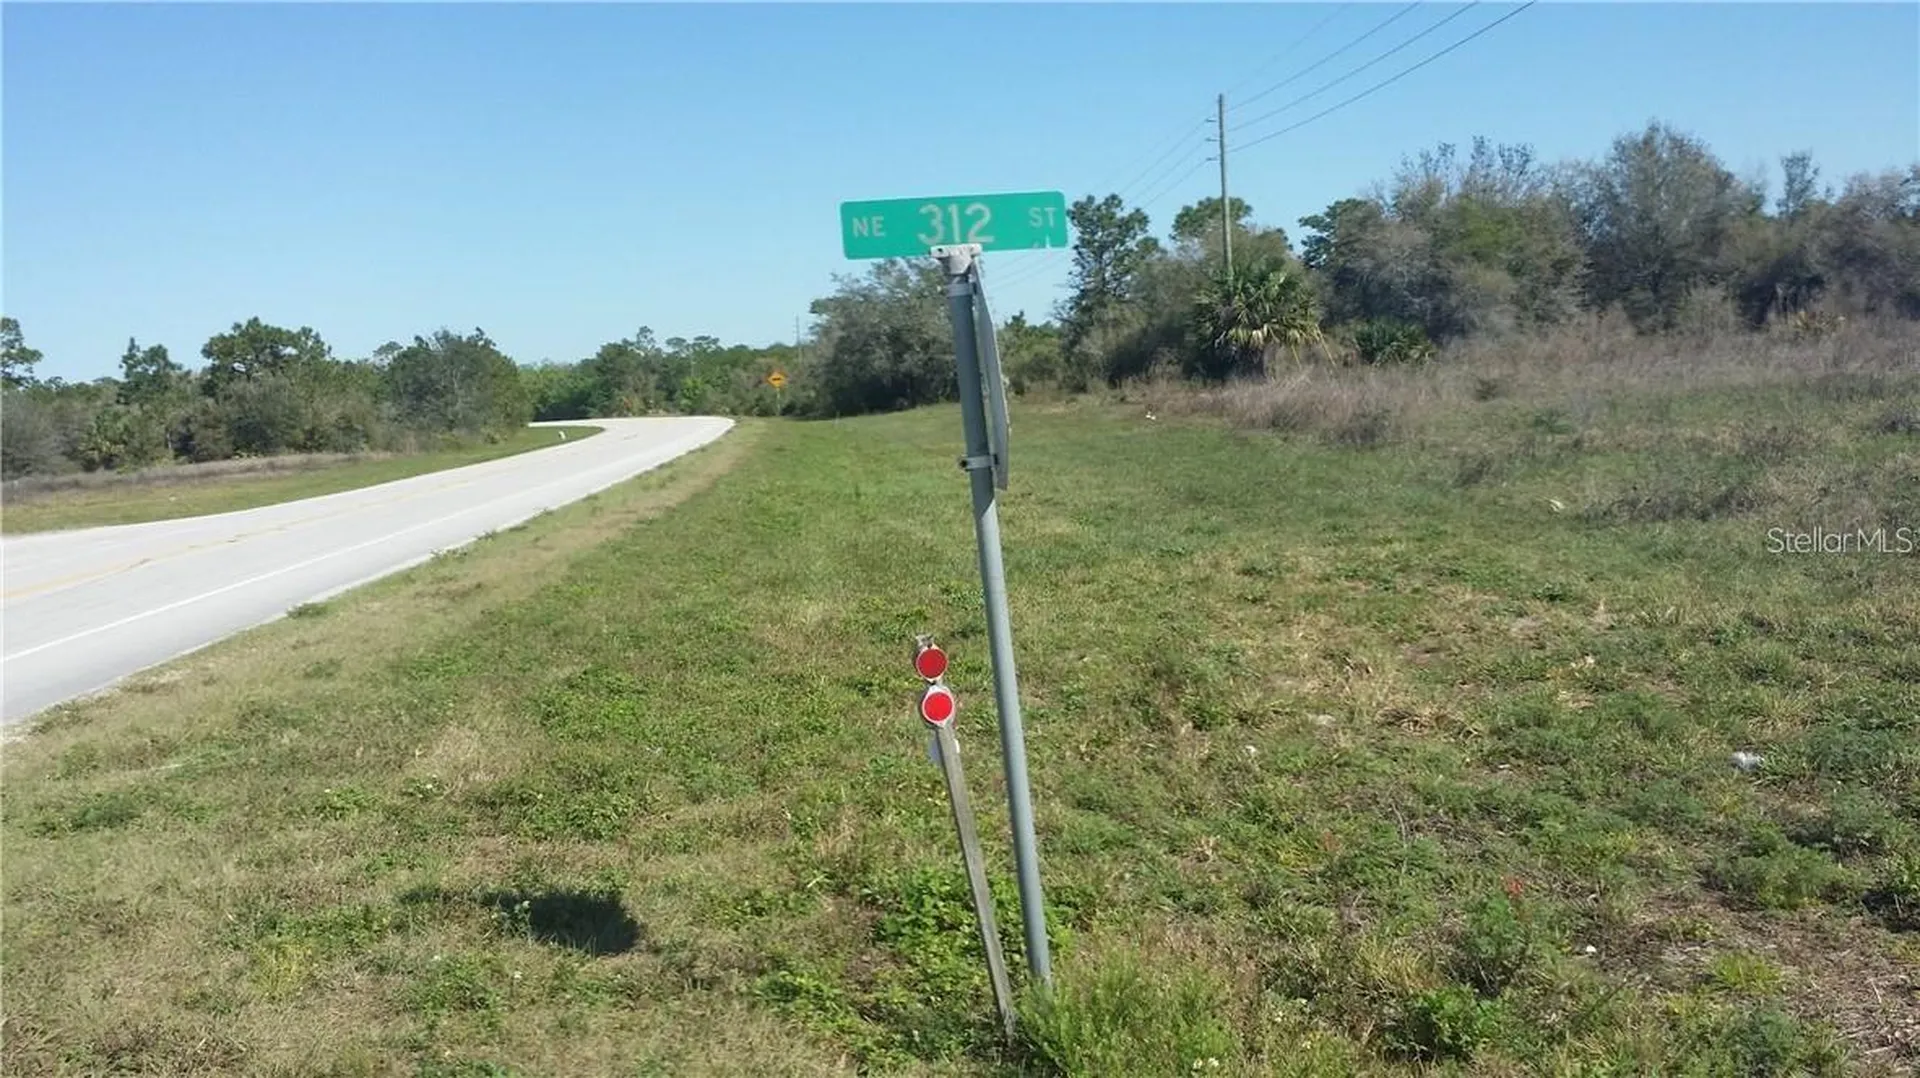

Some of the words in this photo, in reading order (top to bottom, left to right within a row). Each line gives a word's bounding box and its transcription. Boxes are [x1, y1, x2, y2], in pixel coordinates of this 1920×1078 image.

[852, 216, 885, 237] NE
[916, 202, 994, 245] 312
[1028, 207, 1056, 227] ST
